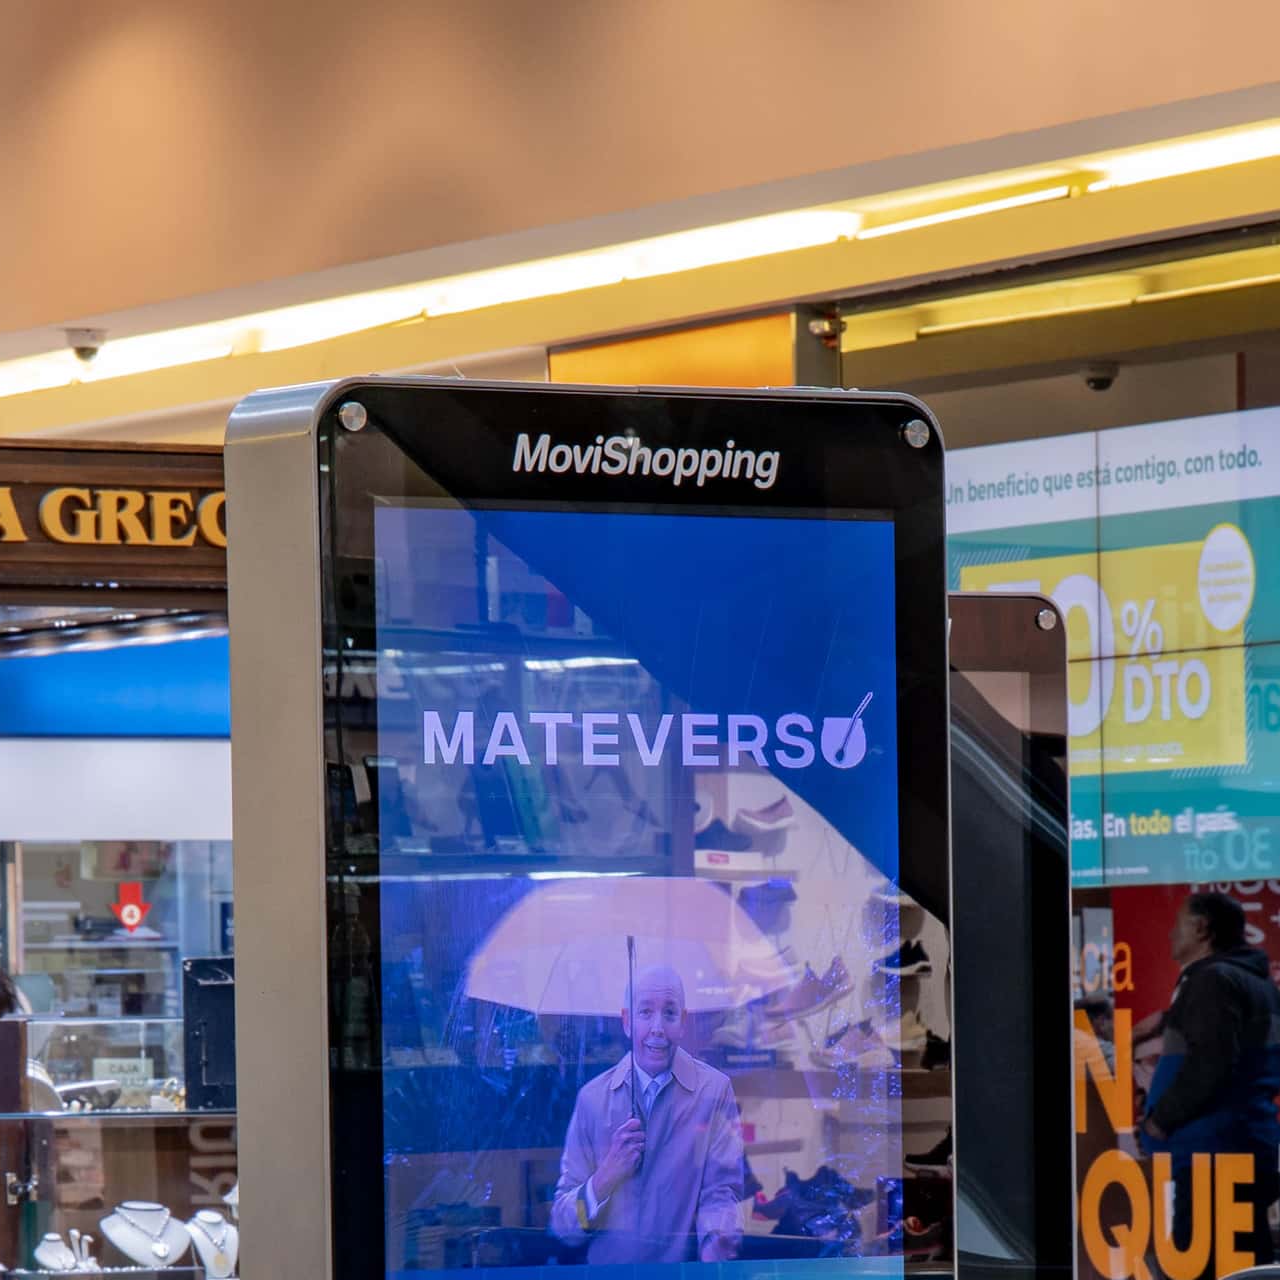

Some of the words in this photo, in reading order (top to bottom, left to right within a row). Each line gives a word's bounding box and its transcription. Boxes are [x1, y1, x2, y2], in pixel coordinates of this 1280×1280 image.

[513, 433, 780, 489] MoviShopping
[968, 474, 1039, 502] beneficio
[1043, 471, 1072, 497] que
[1077, 462, 1111, 489] está
[1115, 456, 1180, 485] contigo,
[1184, 454, 1214, 475] con
[1219, 444, 1263, 473] todo.
[1124, 659, 1211, 724] DTO
[1104, 814, 1125, 837] En
[1129, 809, 1170, 836] todo
[1175, 807, 1193, 833] el
[126, 908, 137, 922] 4
